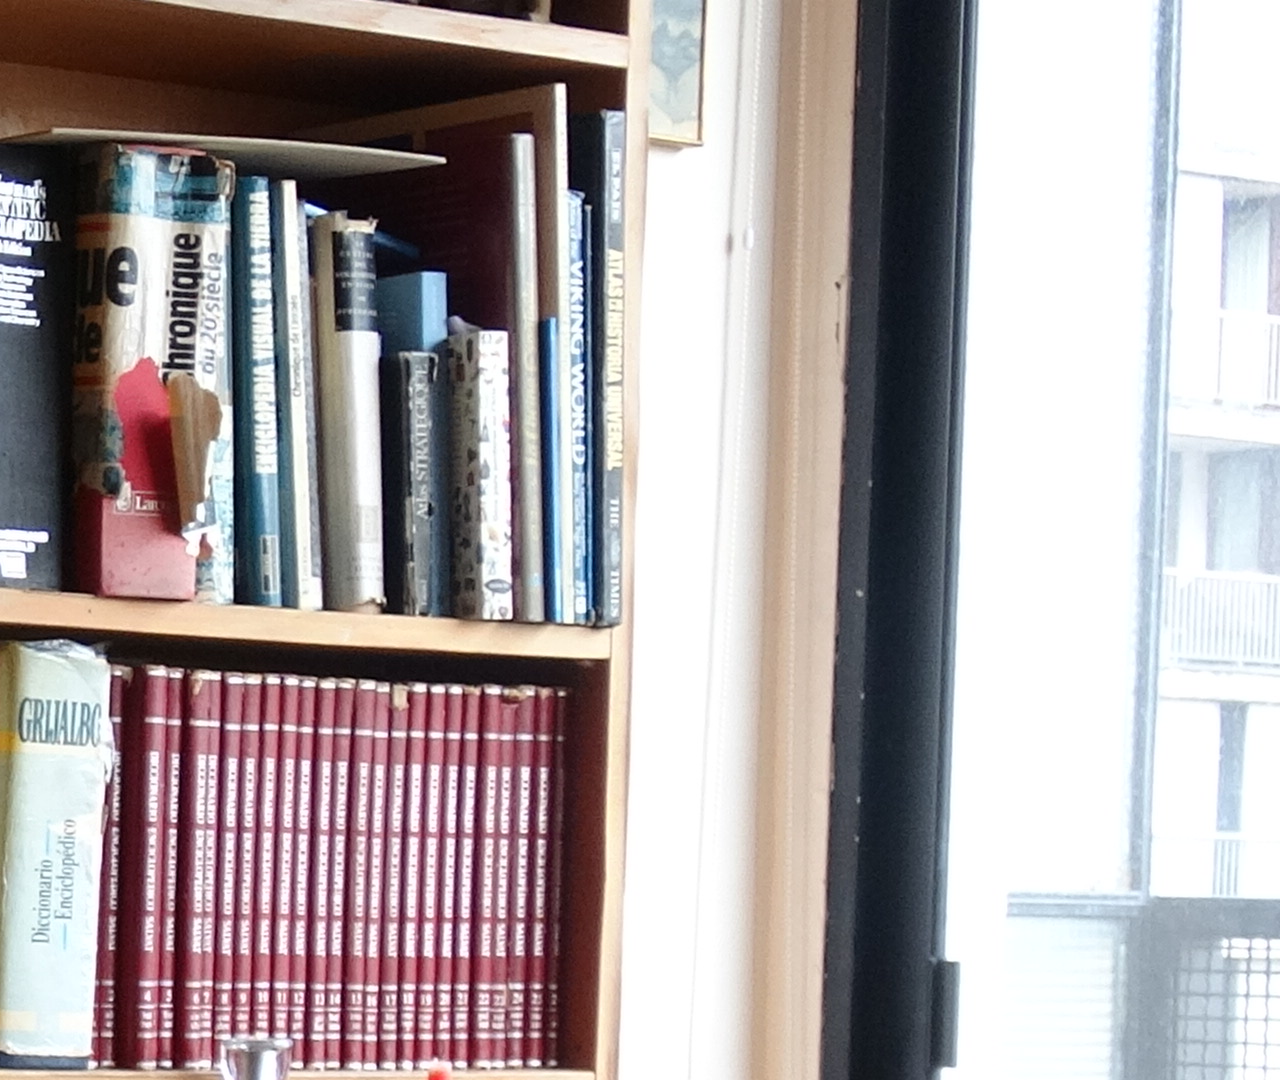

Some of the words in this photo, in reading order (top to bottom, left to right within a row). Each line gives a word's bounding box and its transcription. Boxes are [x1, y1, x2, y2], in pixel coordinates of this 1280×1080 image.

[250, 252, 271, 274] LA
[251, 278, 272, 299] DE
[608, 249, 623, 296] ATLAS
[251, 304, 275, 360] VISUAL
[570, 260, 584, 355] VIKING
[607, 311, 623, 383] HISTORIA
[253, 364, 278, 474] ENCICLOPEDIA
[571, 363, 585, 466] WORLD
[607, 385, 623, 471] UNIVERSAL
[31, 859, 53, 944] Diccionario
[54, 819, 79, 921] Enciclopédico
